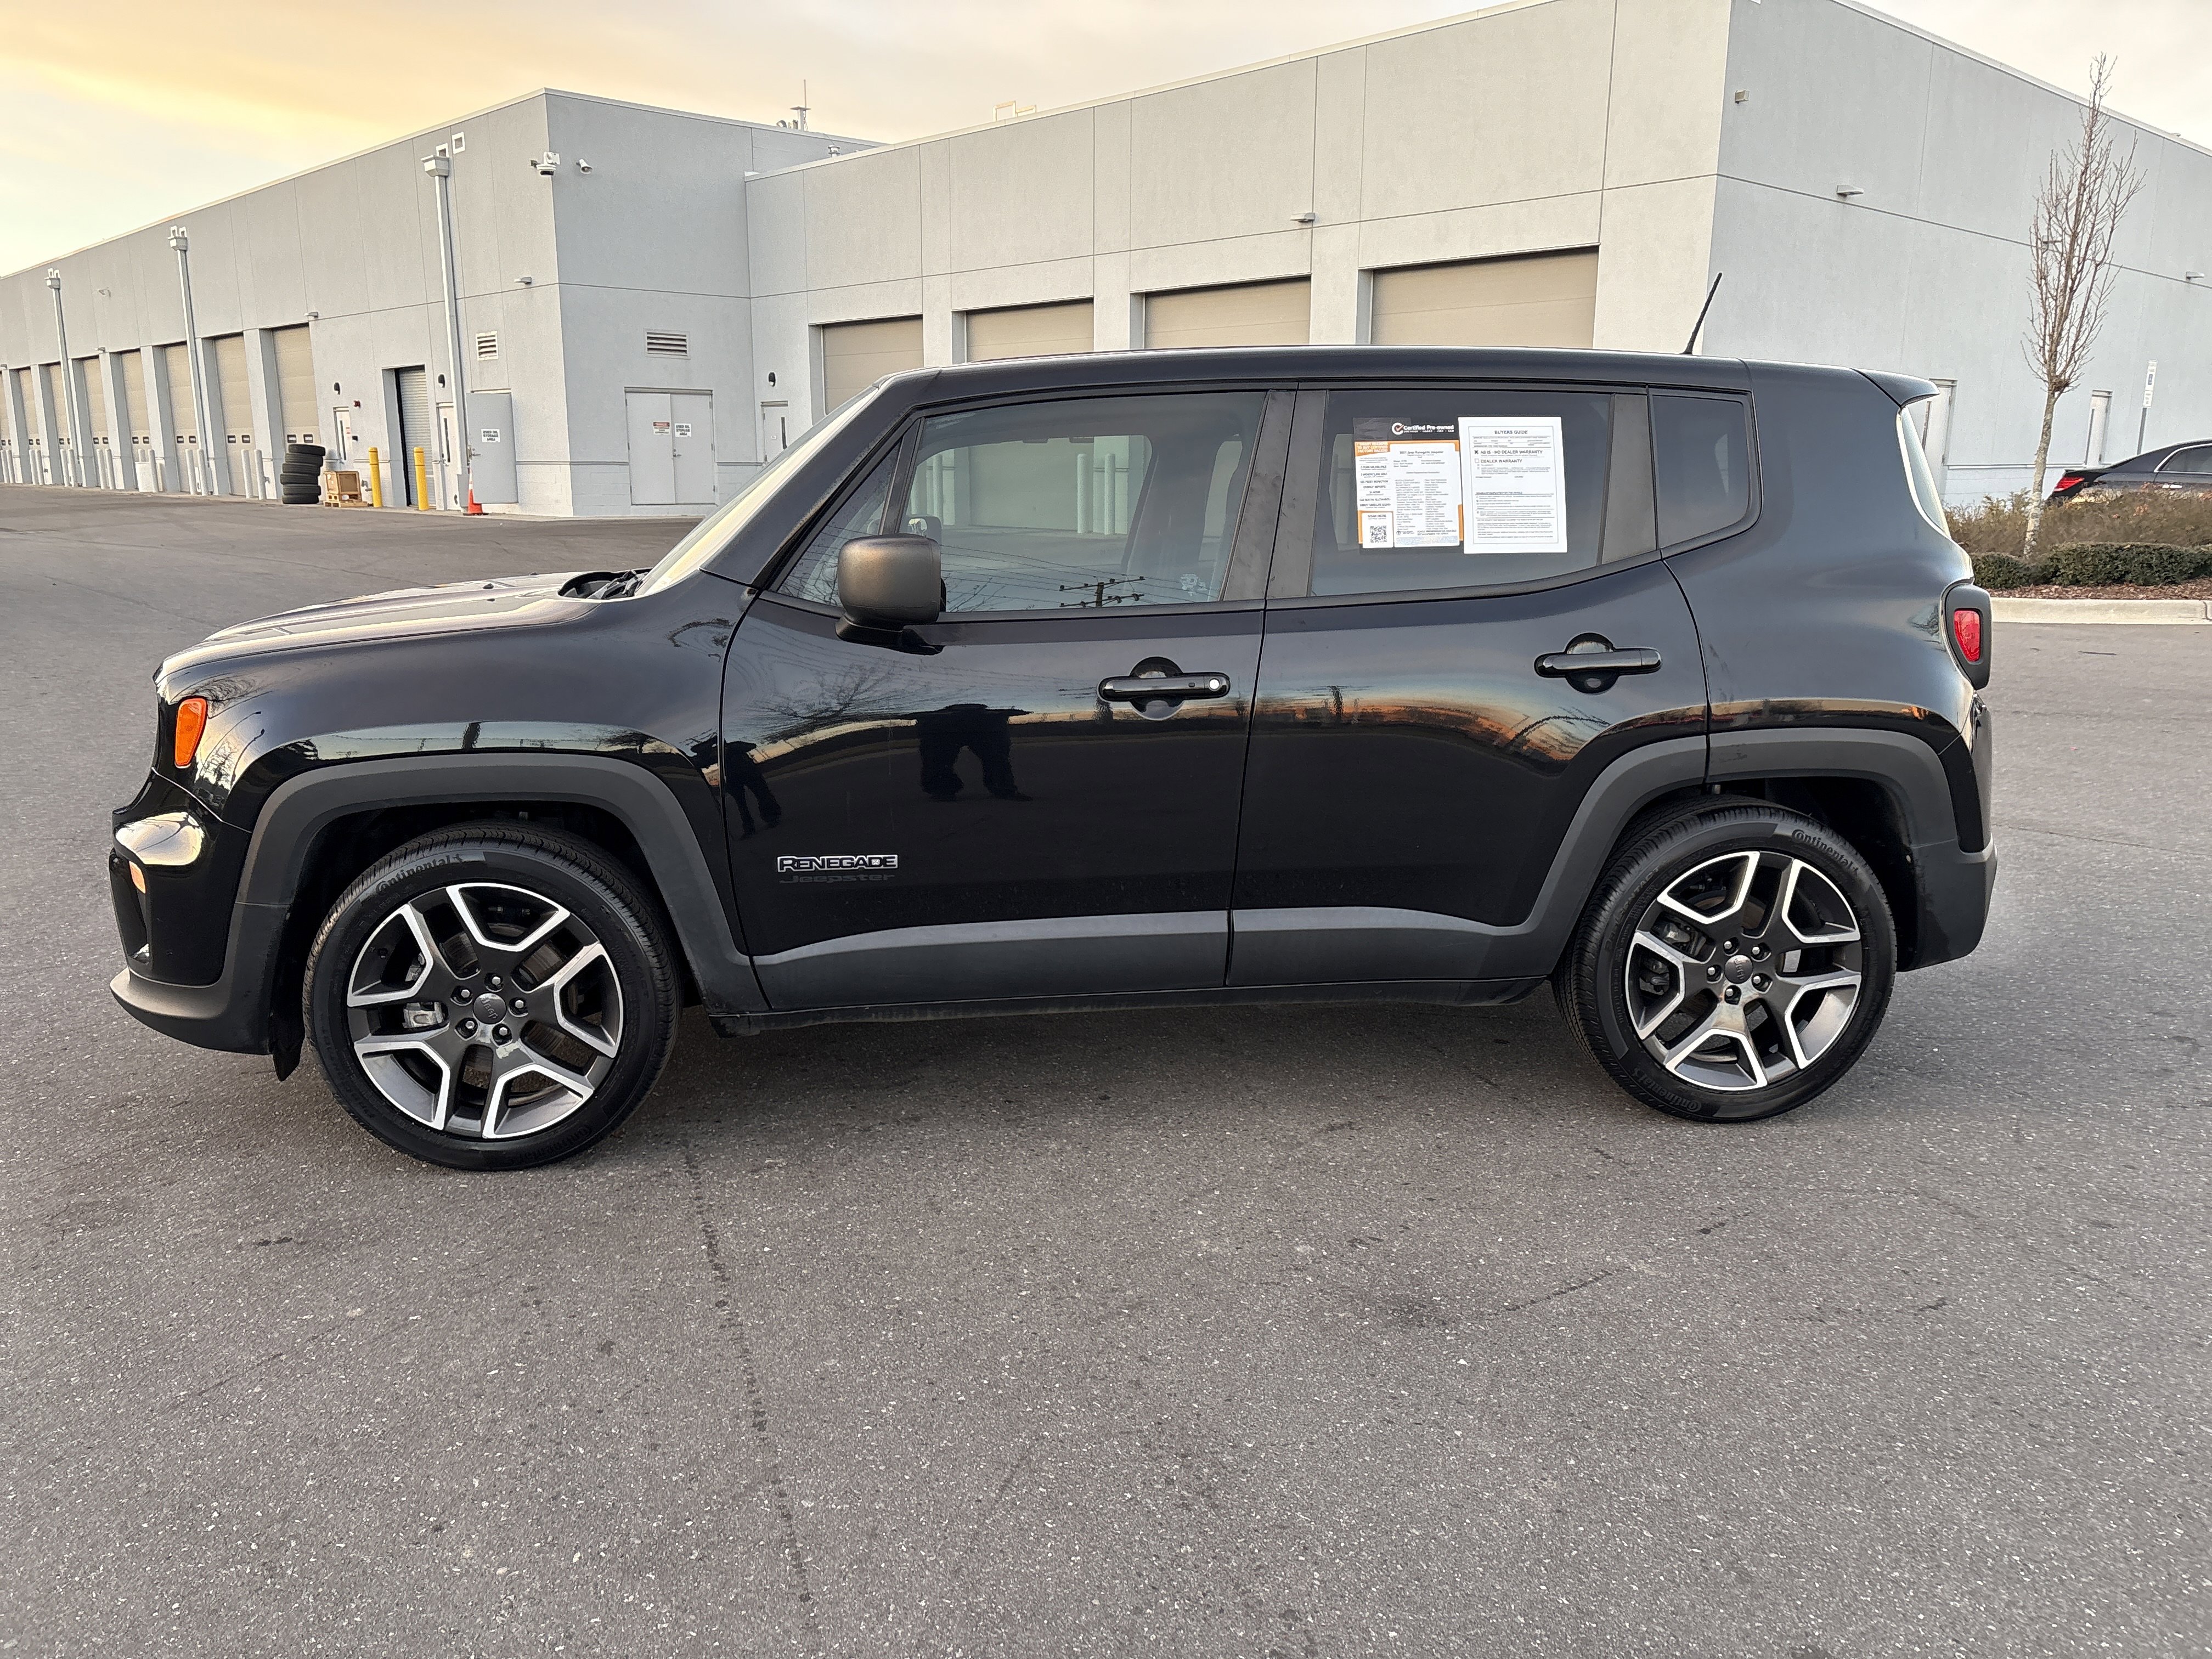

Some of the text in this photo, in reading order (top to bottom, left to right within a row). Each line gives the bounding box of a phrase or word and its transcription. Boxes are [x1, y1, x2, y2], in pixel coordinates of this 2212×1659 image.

[1791, 829, 1854, 870] Continental
[375, 855, 451, 892] Continental
[777, 854, 898, 872] RENEGADE
[779, 874, 895, 884] Jeepster
[1734, 959, 1745, 980] Jeep
[480, 998, 498, 1019] Jeep
